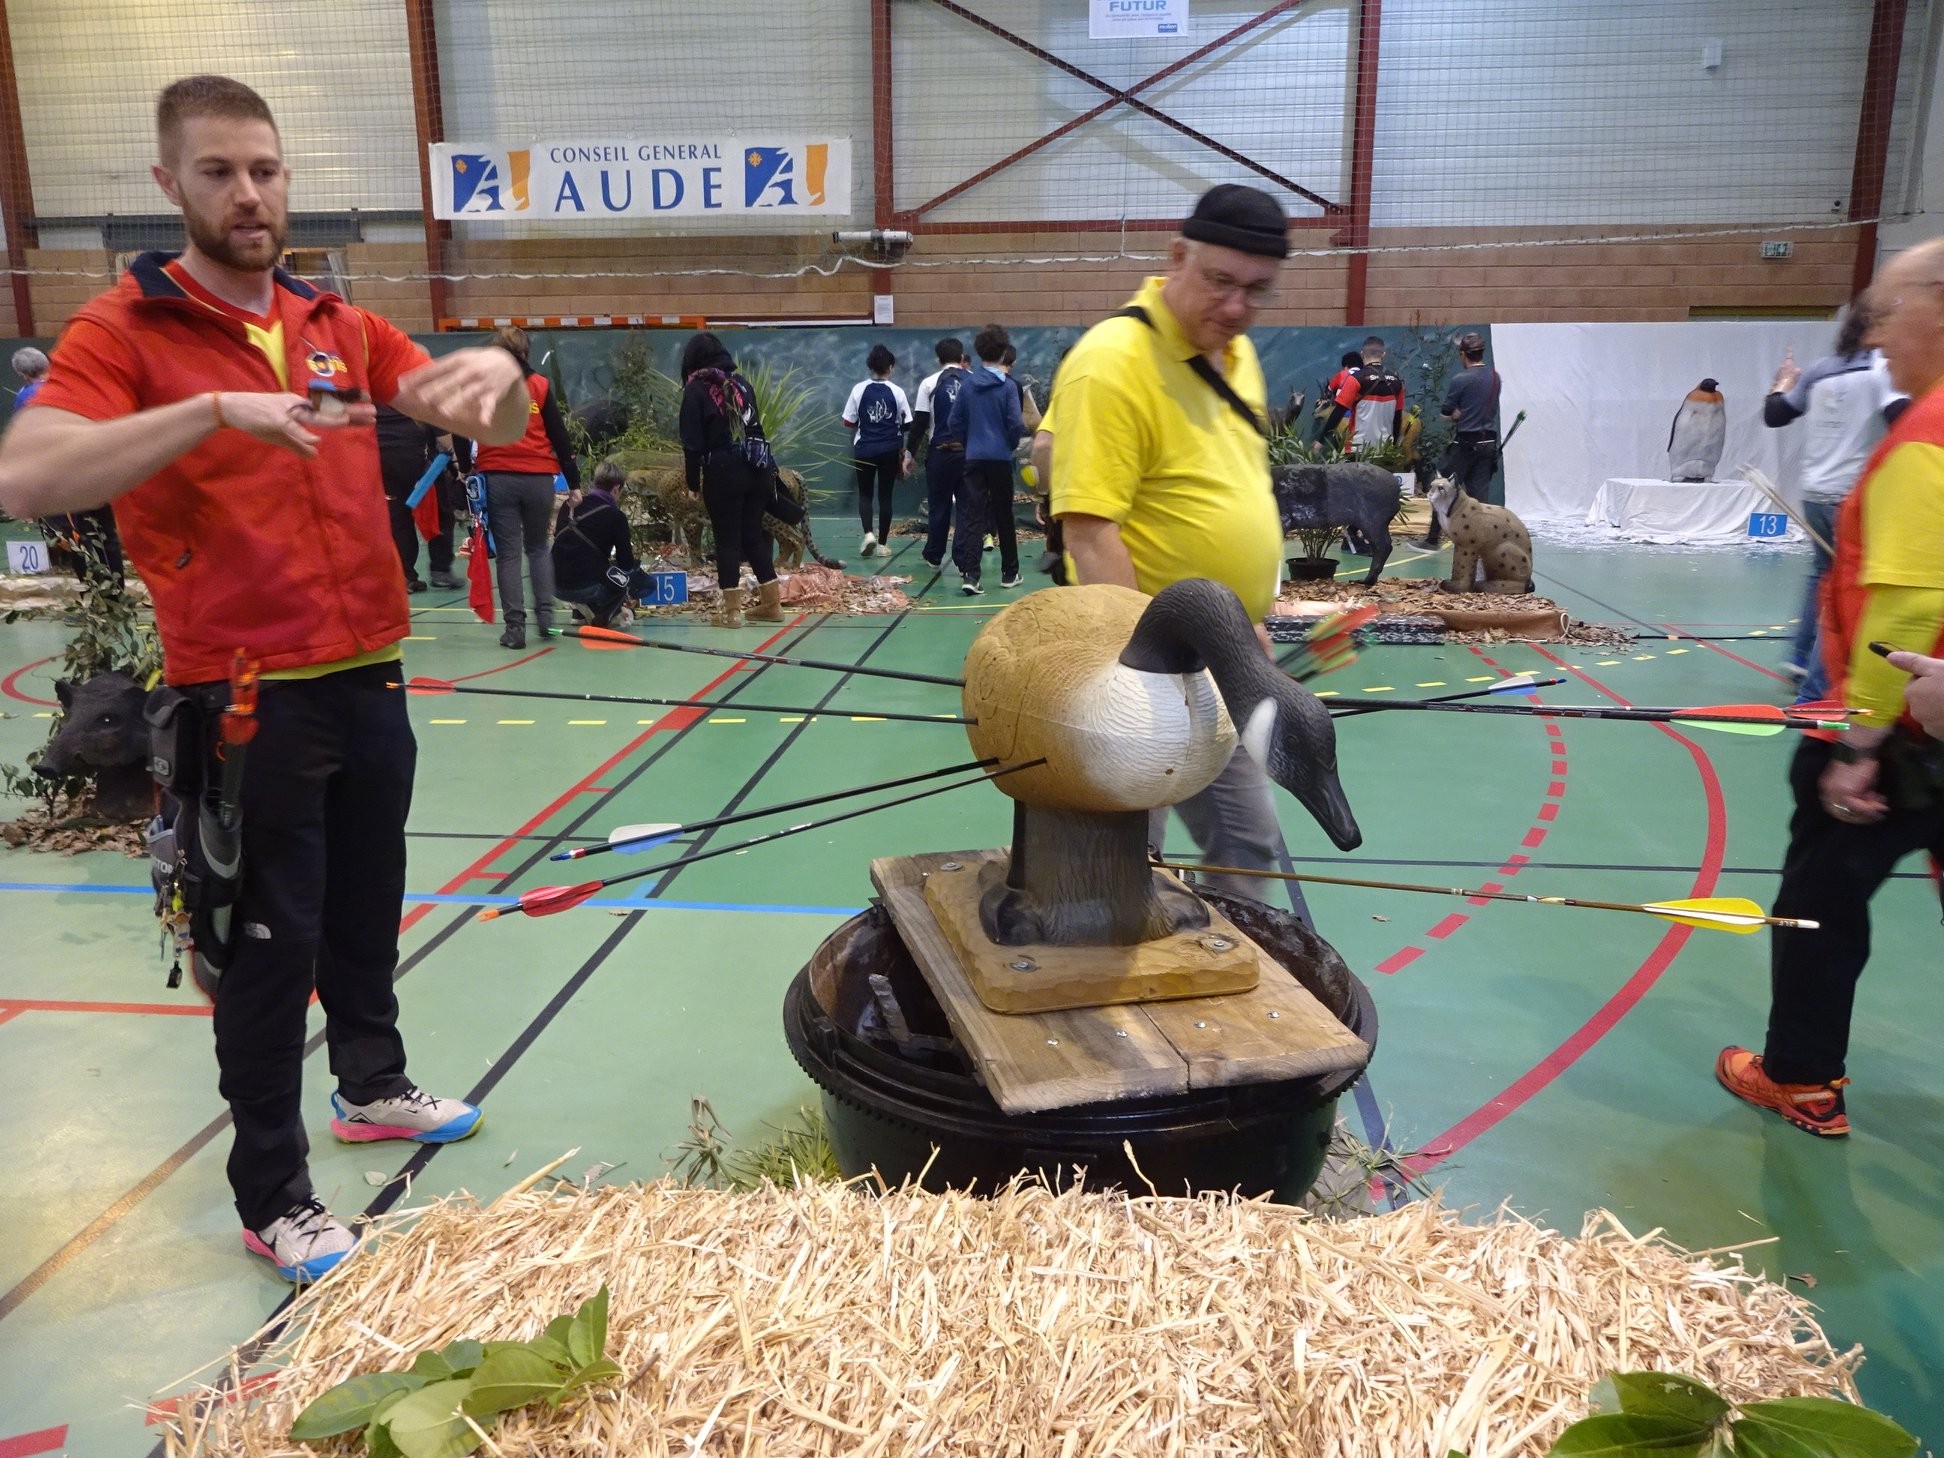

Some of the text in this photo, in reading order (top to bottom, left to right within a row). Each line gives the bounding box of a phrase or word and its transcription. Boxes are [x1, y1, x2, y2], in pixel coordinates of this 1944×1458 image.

[1109, 0, 1167, 12] FUTUR
[550, 144, 722, 163] CONSEIL GENERAL
[554, 167, 723, 213] AUDE
[1759, 515, 1777, 535] 13
[20, 545, 39, 570] 20
[656, 576, 675, 601] 15
